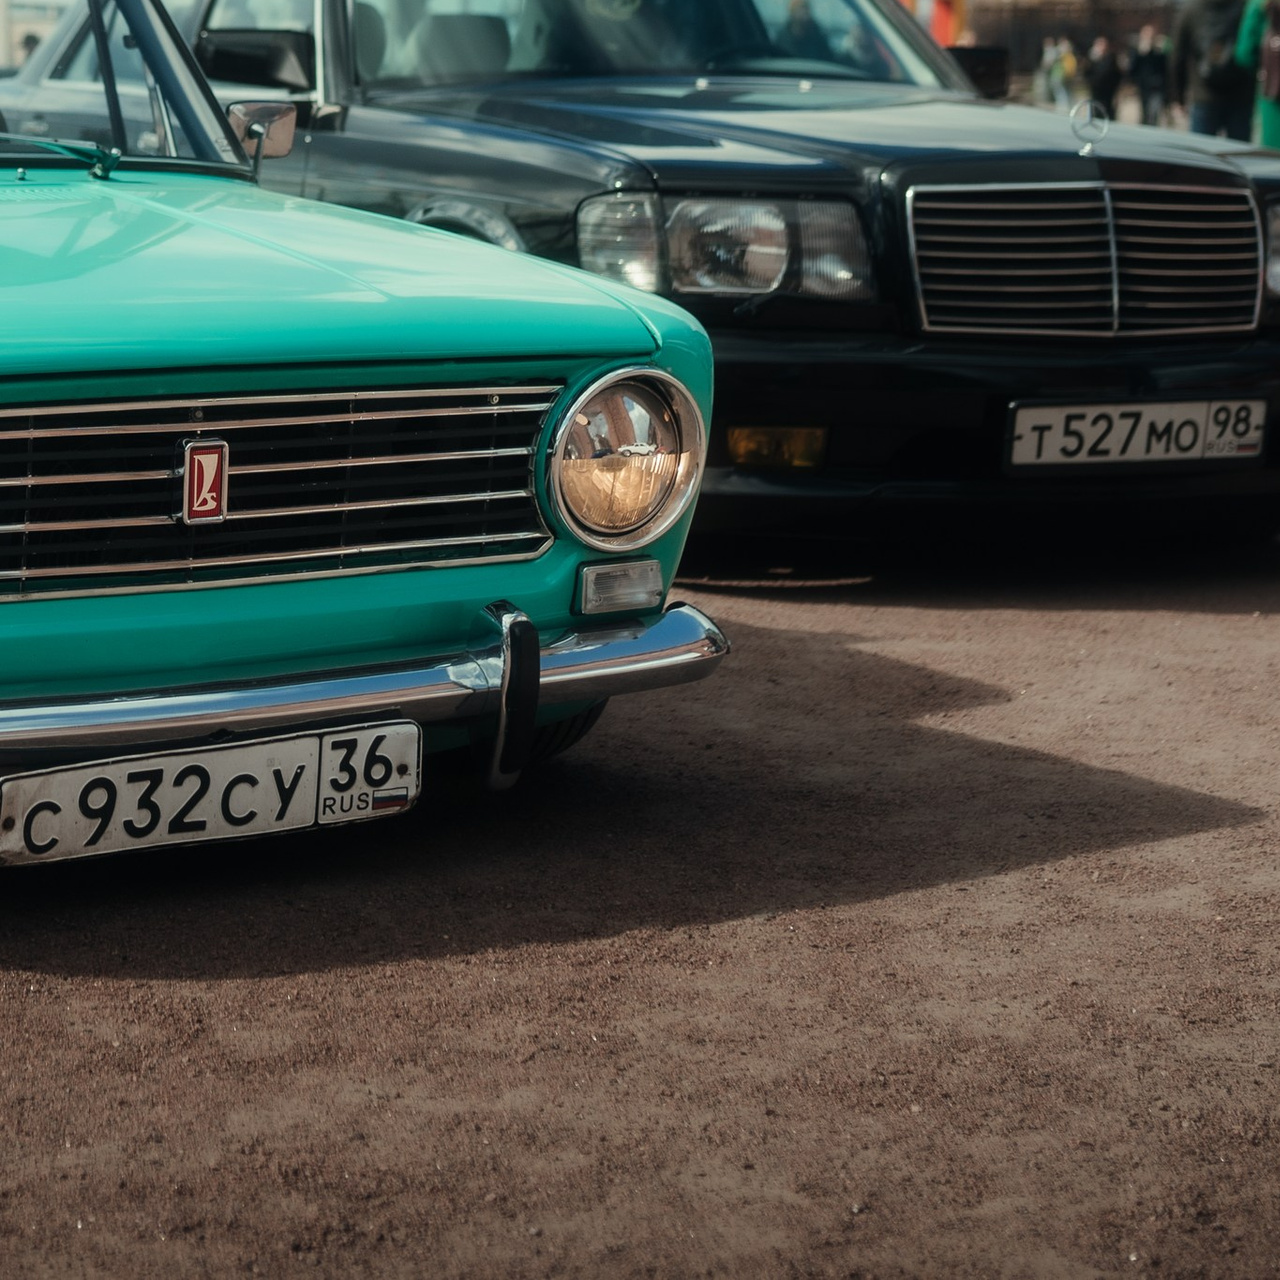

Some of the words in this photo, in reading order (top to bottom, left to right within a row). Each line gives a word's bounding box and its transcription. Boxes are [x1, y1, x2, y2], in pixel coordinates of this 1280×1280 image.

[1213, 404, 1252, 440] 98
[1207, 439, 1237, 454] RUS
[329, 734, 393, 793] 36
[322, 792, 370, 816] RUS
